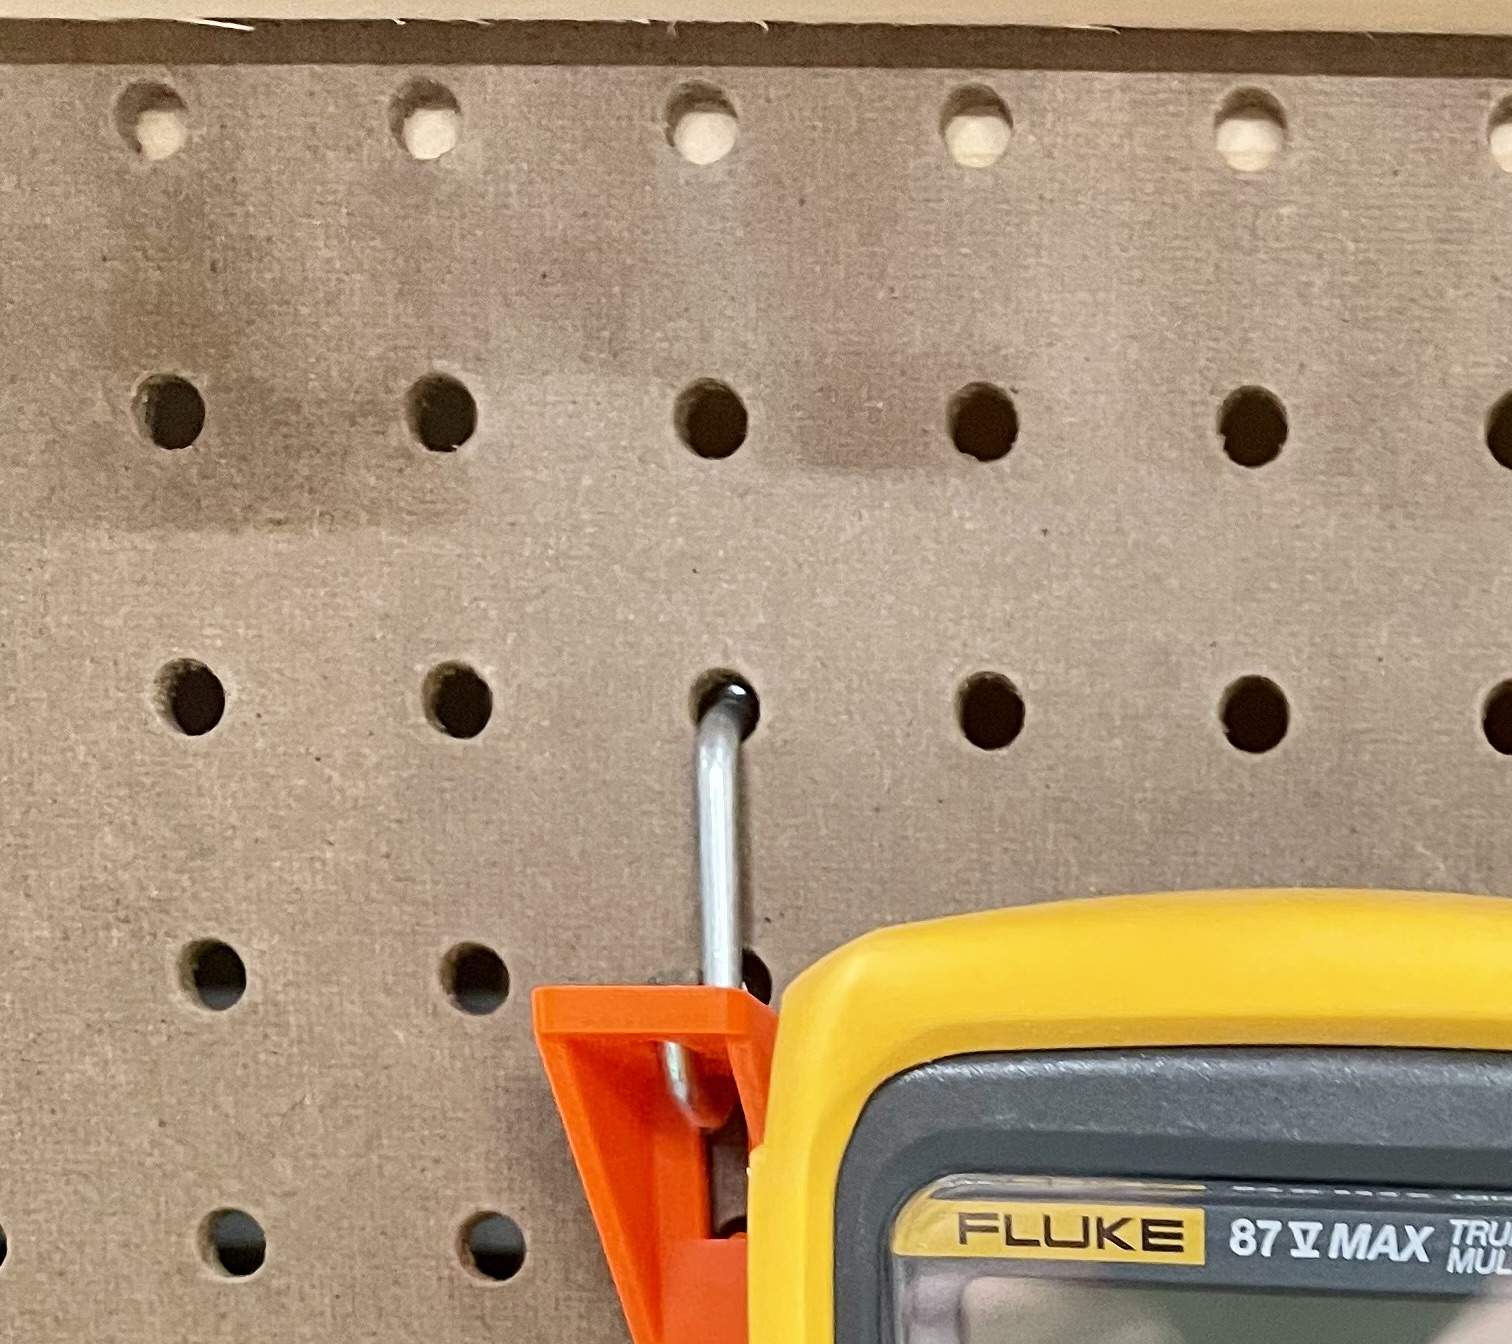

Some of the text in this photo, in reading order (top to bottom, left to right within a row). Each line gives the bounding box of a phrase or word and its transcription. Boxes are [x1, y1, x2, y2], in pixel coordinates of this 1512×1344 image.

[957, 1211, 1184, 1253] FLUKE
[1229, 1218, 1282, 1257] 87
[1328, 1222, 1434, 1263] MAX
